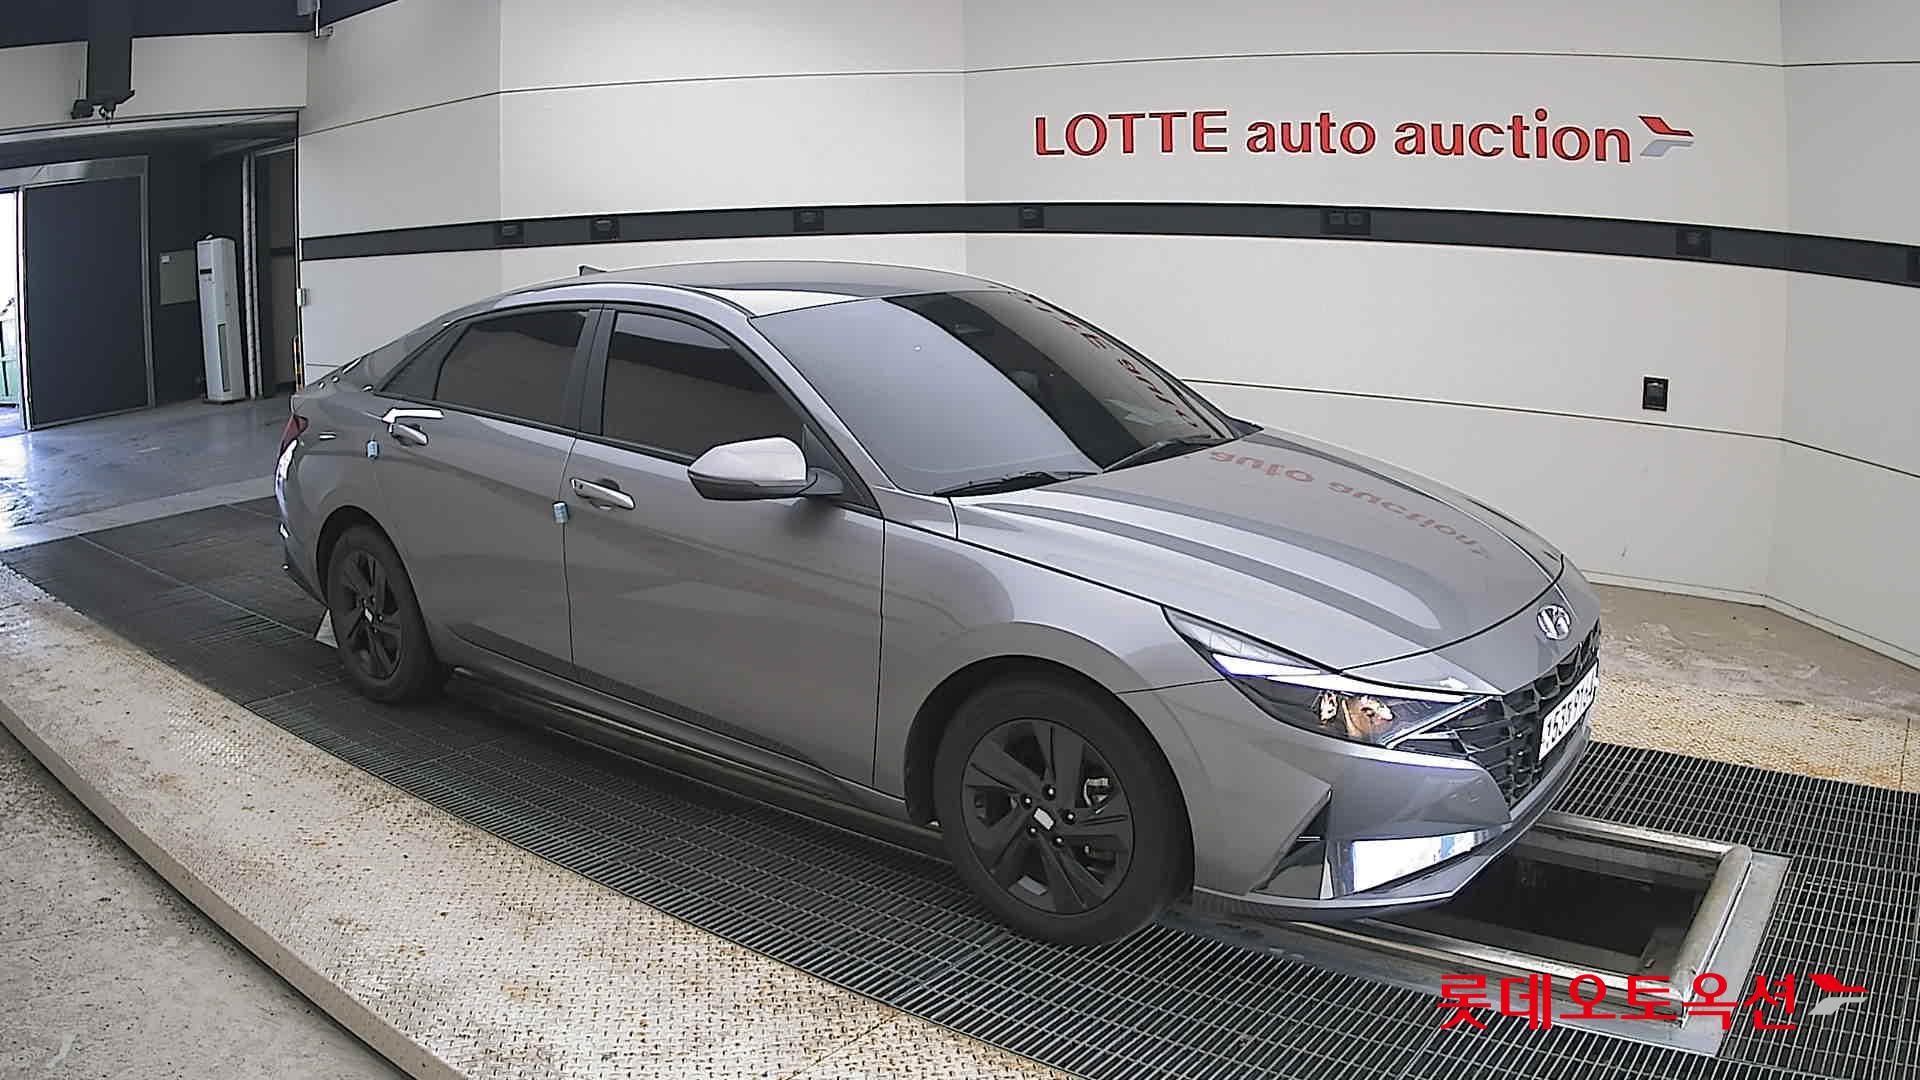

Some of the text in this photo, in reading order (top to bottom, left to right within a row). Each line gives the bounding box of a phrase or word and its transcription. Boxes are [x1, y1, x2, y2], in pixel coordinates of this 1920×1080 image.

[1035, 108, 1631, 163] LOTTE auto auction
